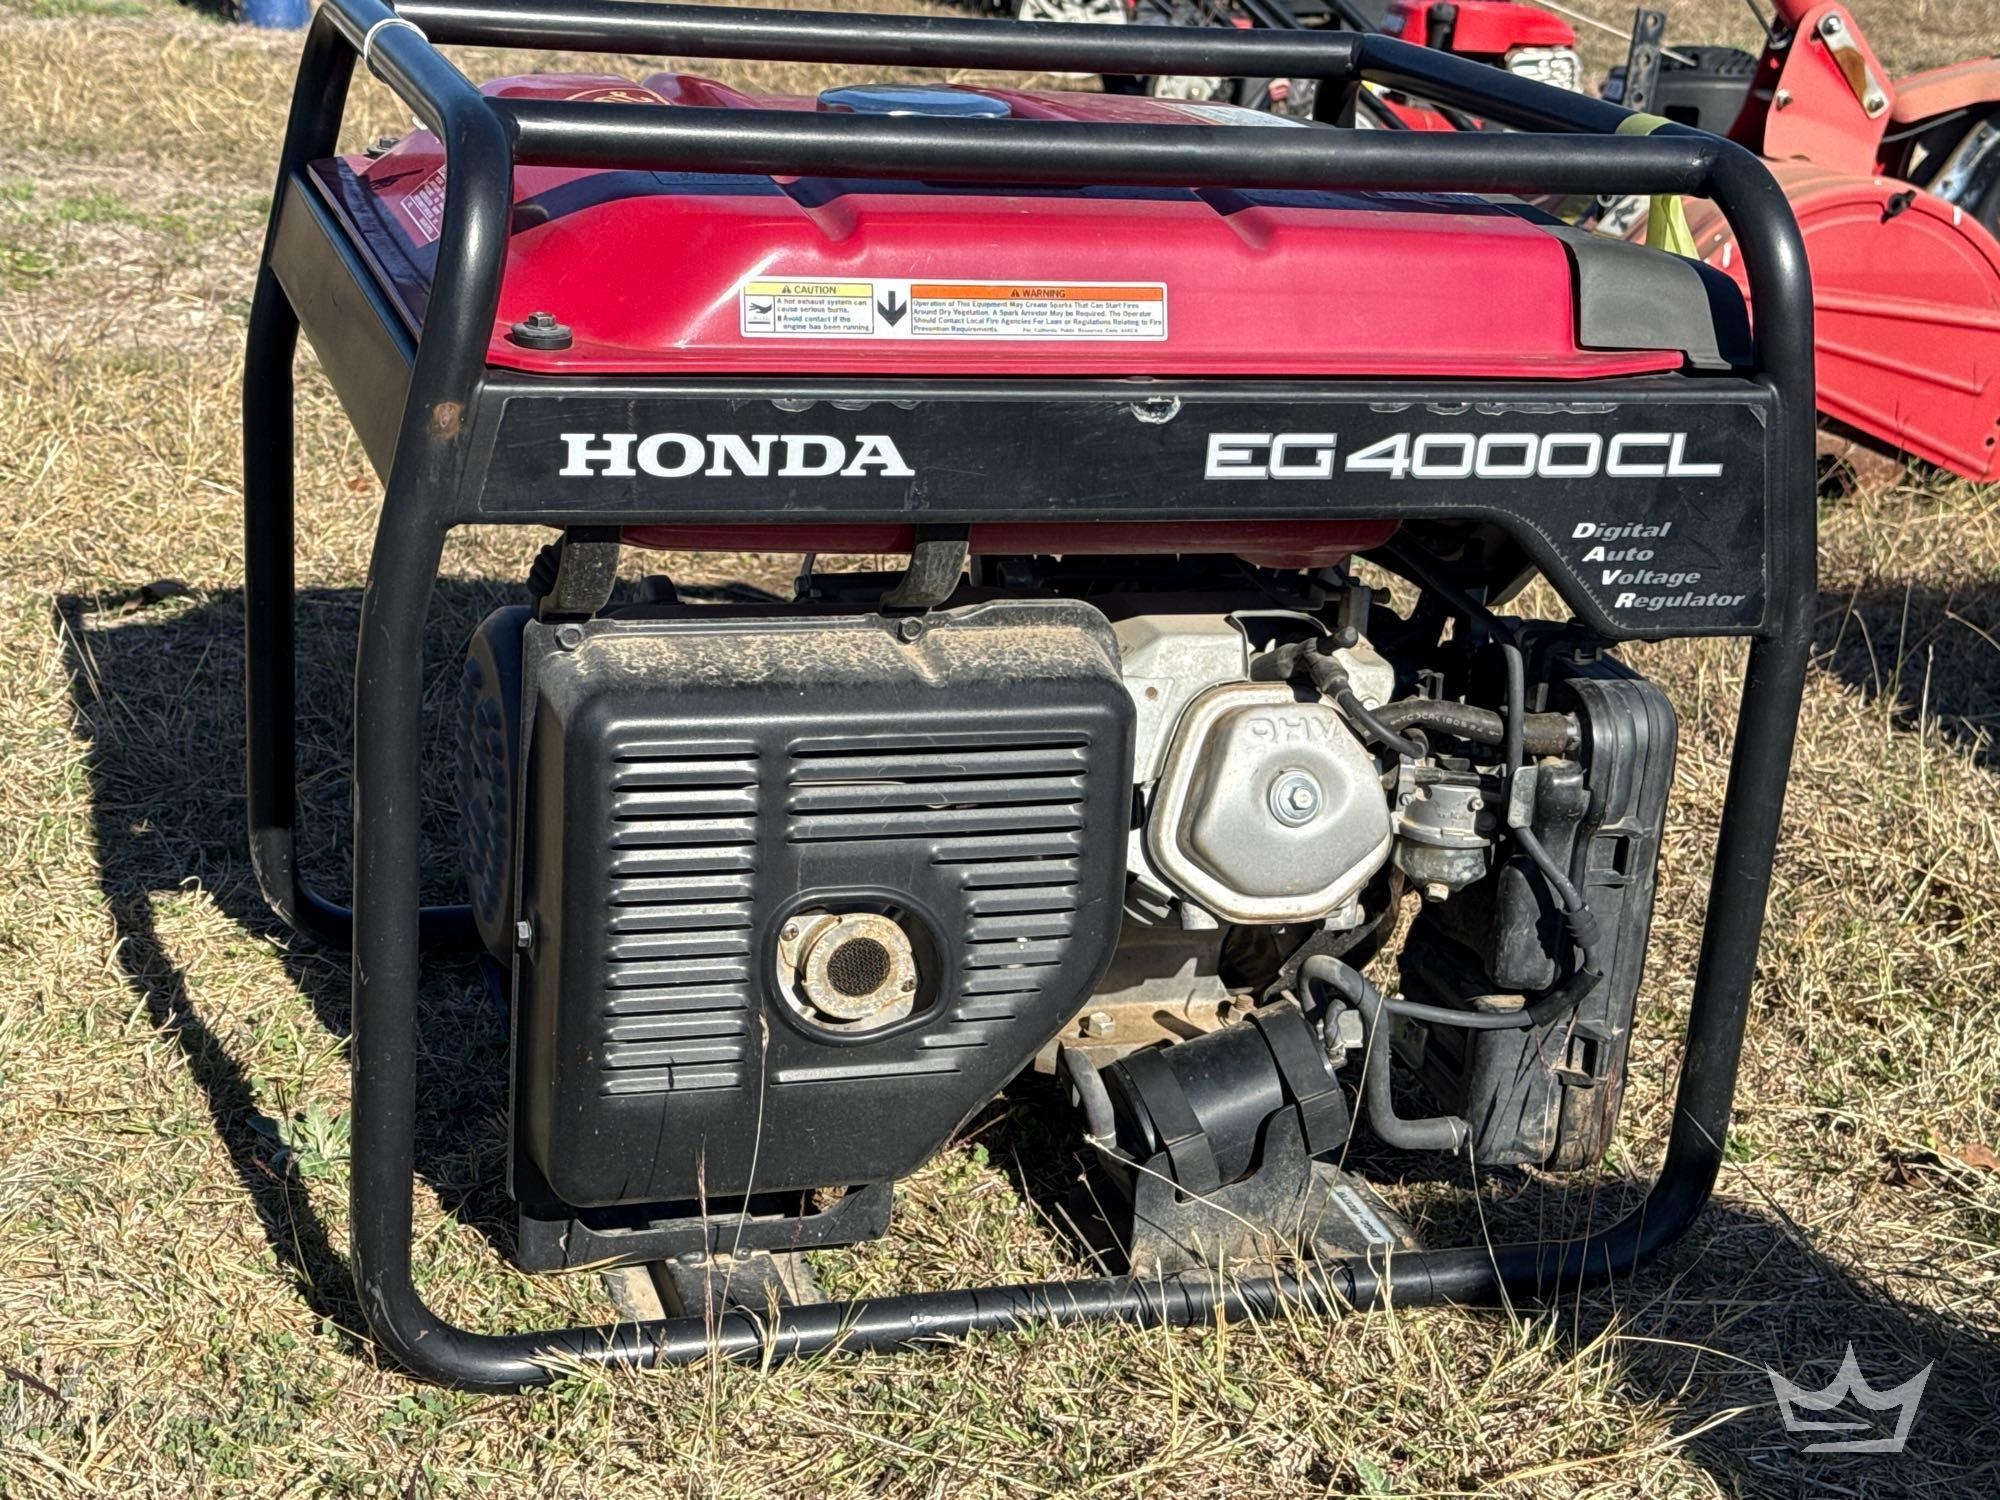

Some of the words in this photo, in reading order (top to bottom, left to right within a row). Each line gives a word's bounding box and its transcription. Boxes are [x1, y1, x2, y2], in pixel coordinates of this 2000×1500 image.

[794, 285, 837, 294] CAUTION
[1022, 289, 1066, 298] WARNING
[559, 432, 916, 477] HONDA
[1571, 521, 1672, 542] Digital
[1581, 546, 1655, 562] Auto
[1601, 569, 1701, 588] Voltage
[1614, 592, 1746, 611] Regulator
[1247, 716, 1338, 741] OHV
